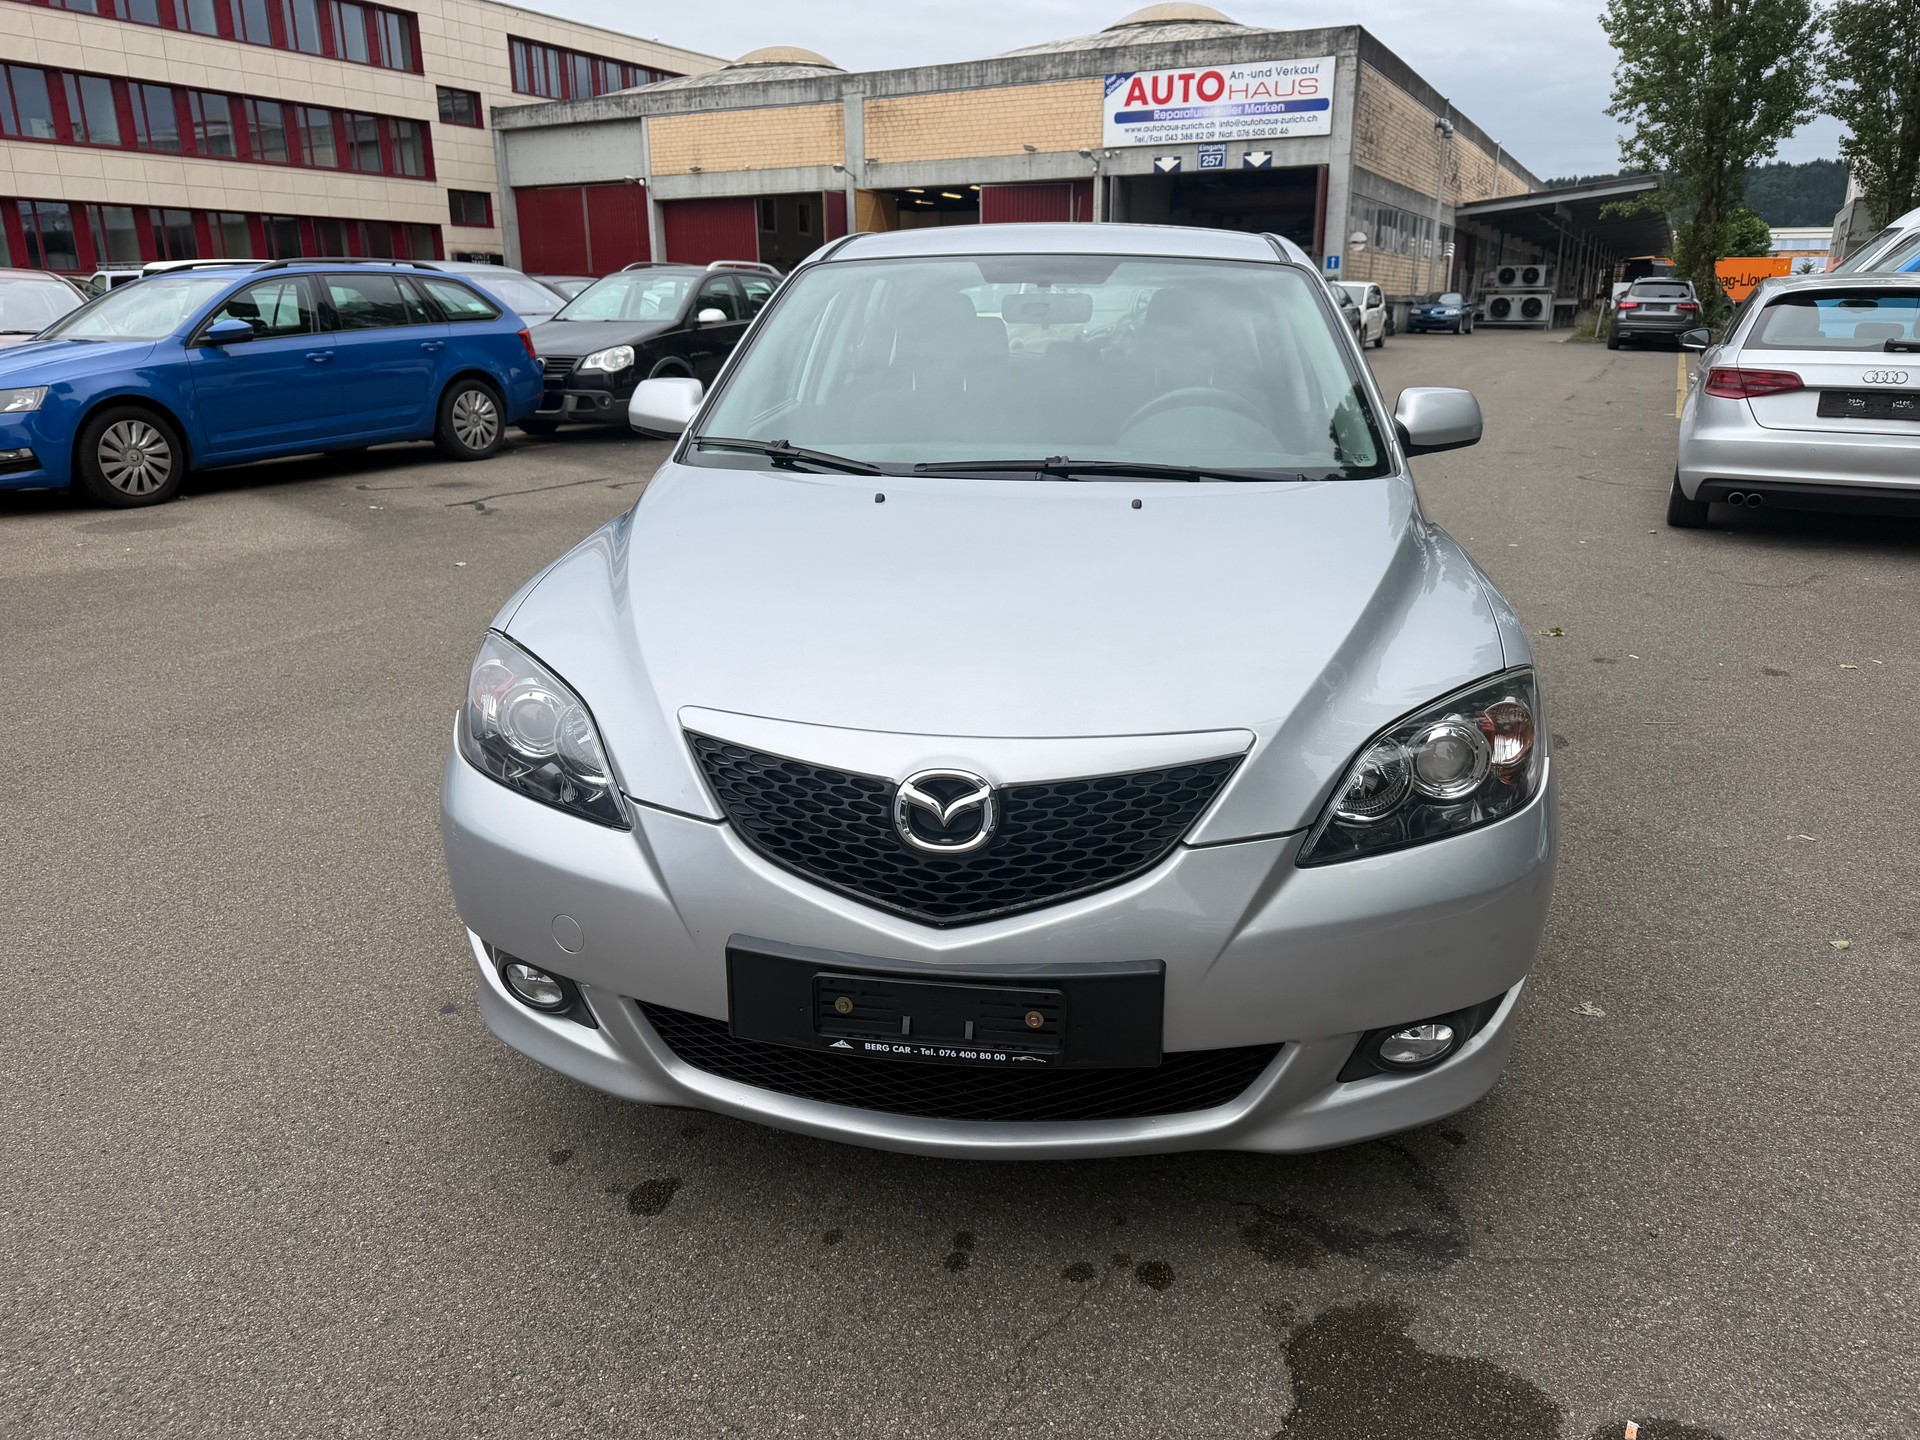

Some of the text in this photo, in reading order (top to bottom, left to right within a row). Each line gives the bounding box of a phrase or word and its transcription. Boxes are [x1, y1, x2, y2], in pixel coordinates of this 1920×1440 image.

[1229, 70, 1244, 80] An
[1275, 63, 1320, 77] Verkauf
[1124, 70, 1319, 107] AUTO HAUS
[1244, 102, 1286, 115] Marken
[1124, 114, 1318, 134] www.autohaus-zurich.ch info@autohaus-zurich.ch
[1164, 133, 1178, 142] 043
[1206, 131, 1215, 139] 09
[1236, 129, 1250, 137] 076
[1267, 127, 1277, 135] 00
[1279, 126, 1289, 135] 46
[1198, 144, 1226, 152] Eingang
[1201, 155, 1222, 166] 257
[864, 1042, 890, 1053] BERG
[892, 1045, 911, 1054] CAR
[920, 1047, 936, 1056] Tel.
[939, 1049, 957, 1058] 076
[959, 1051, 977, 1059] 400
[979, 1052, 992, 1061] 80
[994, 1053, 1006, 1061] 00
